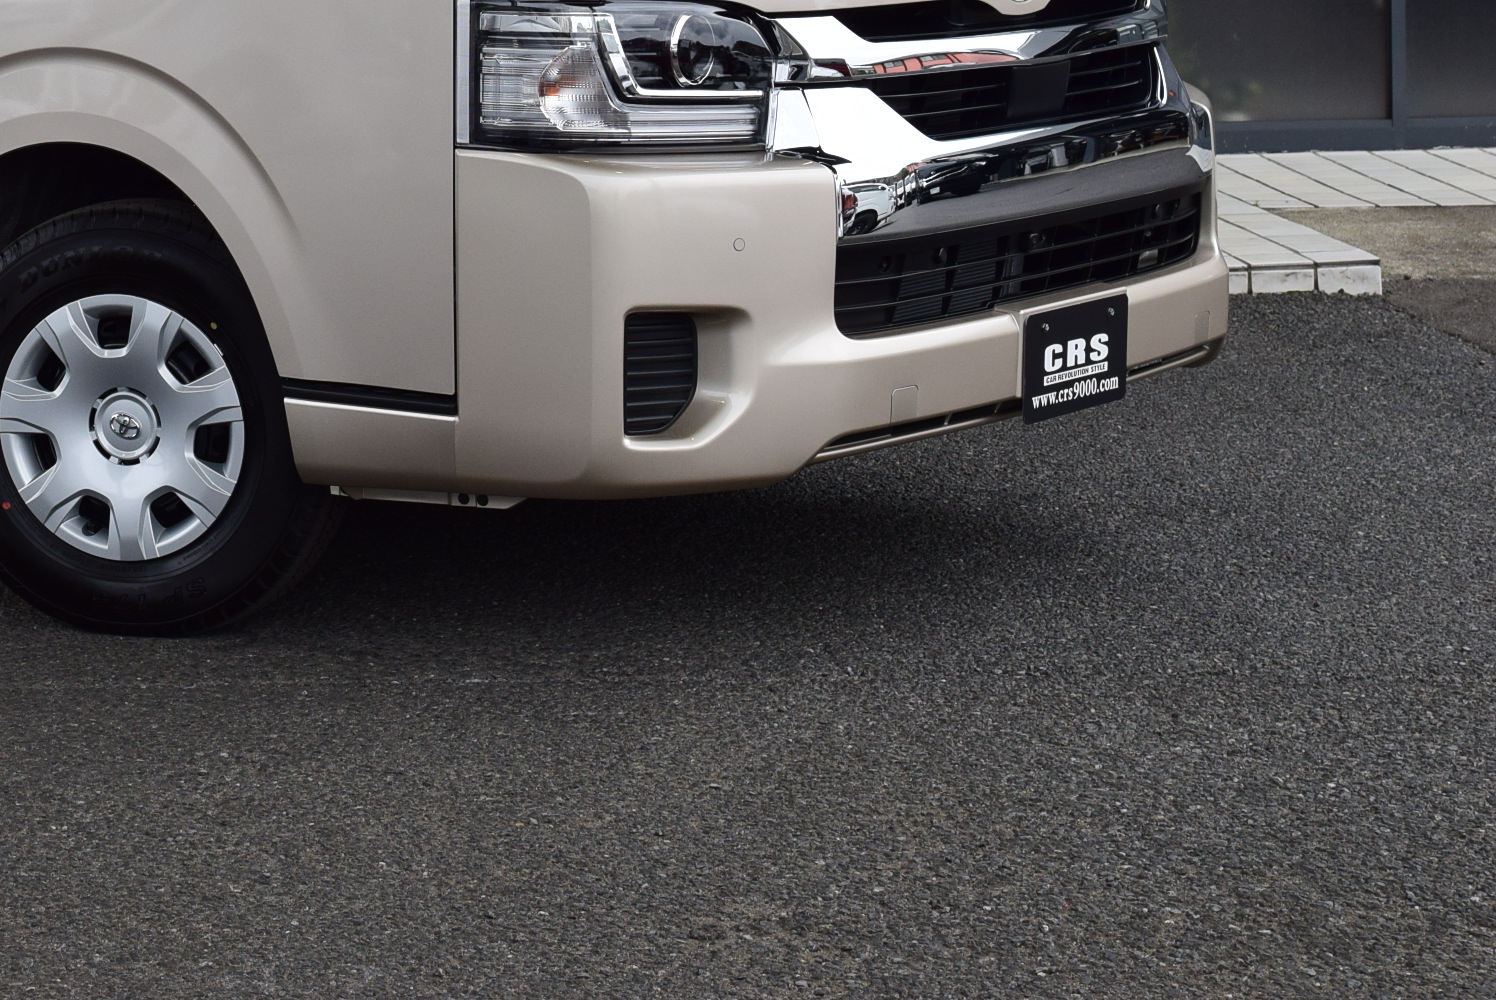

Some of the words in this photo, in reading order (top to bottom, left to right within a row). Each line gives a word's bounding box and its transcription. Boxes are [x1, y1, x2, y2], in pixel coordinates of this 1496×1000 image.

[1044, 333, 1109, 372] CRS
[1046, 373, 1057, 384] CAR
[1057, 367, 1089, 380] REVOLUTION
[1090, 363, 1106, 373] STYLE
[1032, 376, 1119, 409] www.crs9000.com
[162, 577, 207, 610] SP
